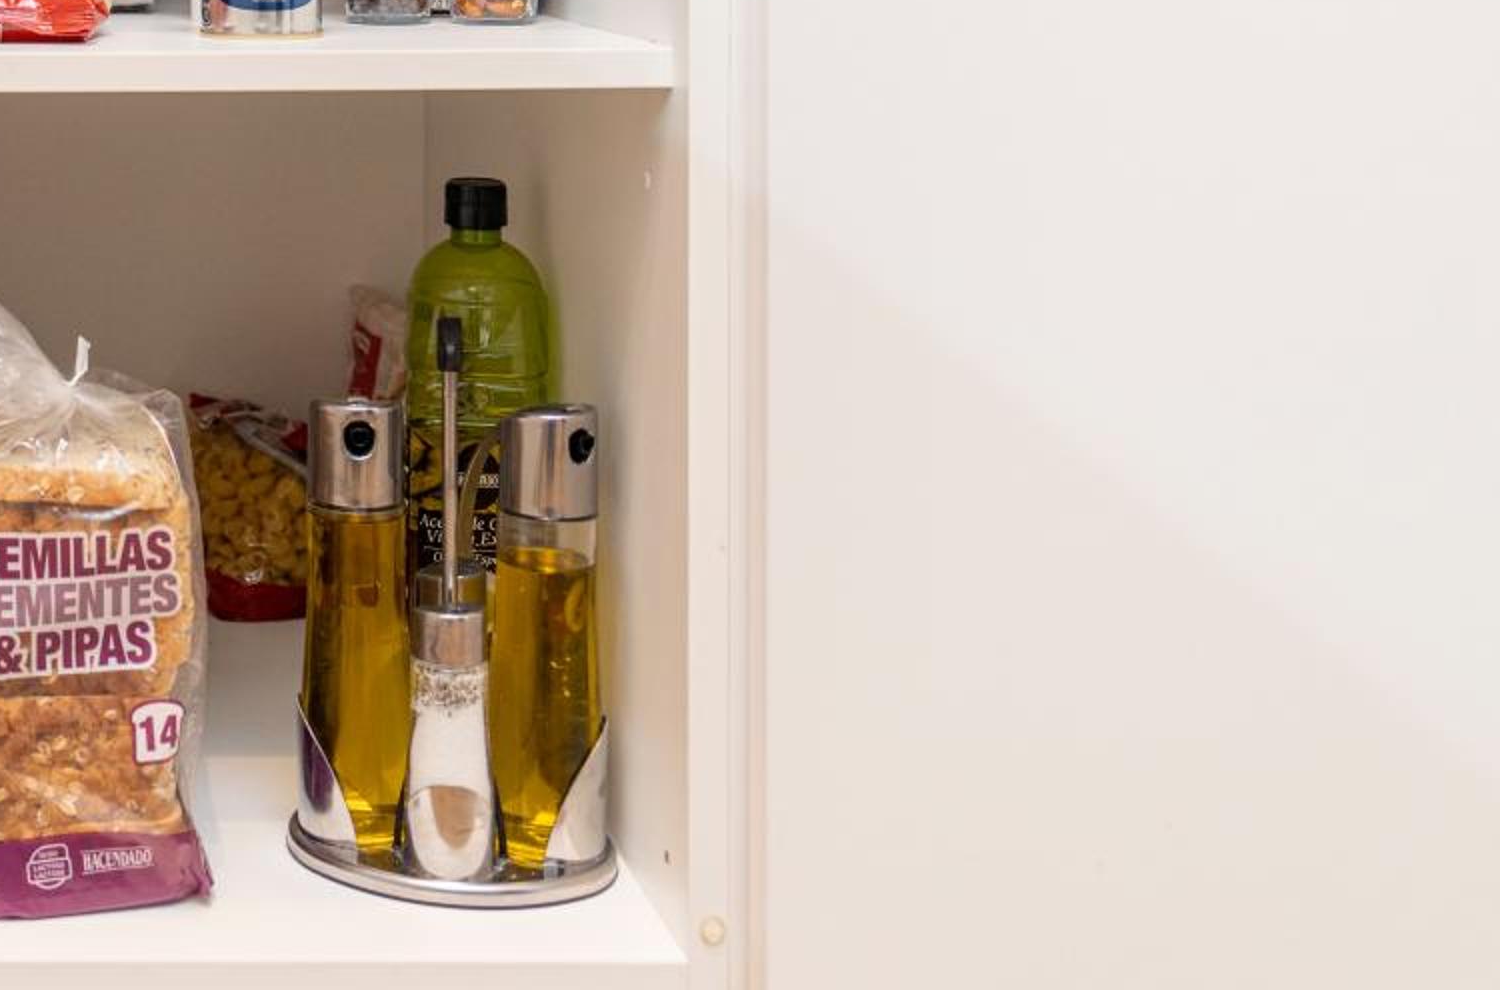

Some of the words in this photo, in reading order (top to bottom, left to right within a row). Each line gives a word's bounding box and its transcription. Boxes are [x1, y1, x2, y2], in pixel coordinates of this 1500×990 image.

[36, 621, 153, 672] PIPAS
[139, 715, 178, 753] 14
[82, 848, 154, 874] HACENDADO
